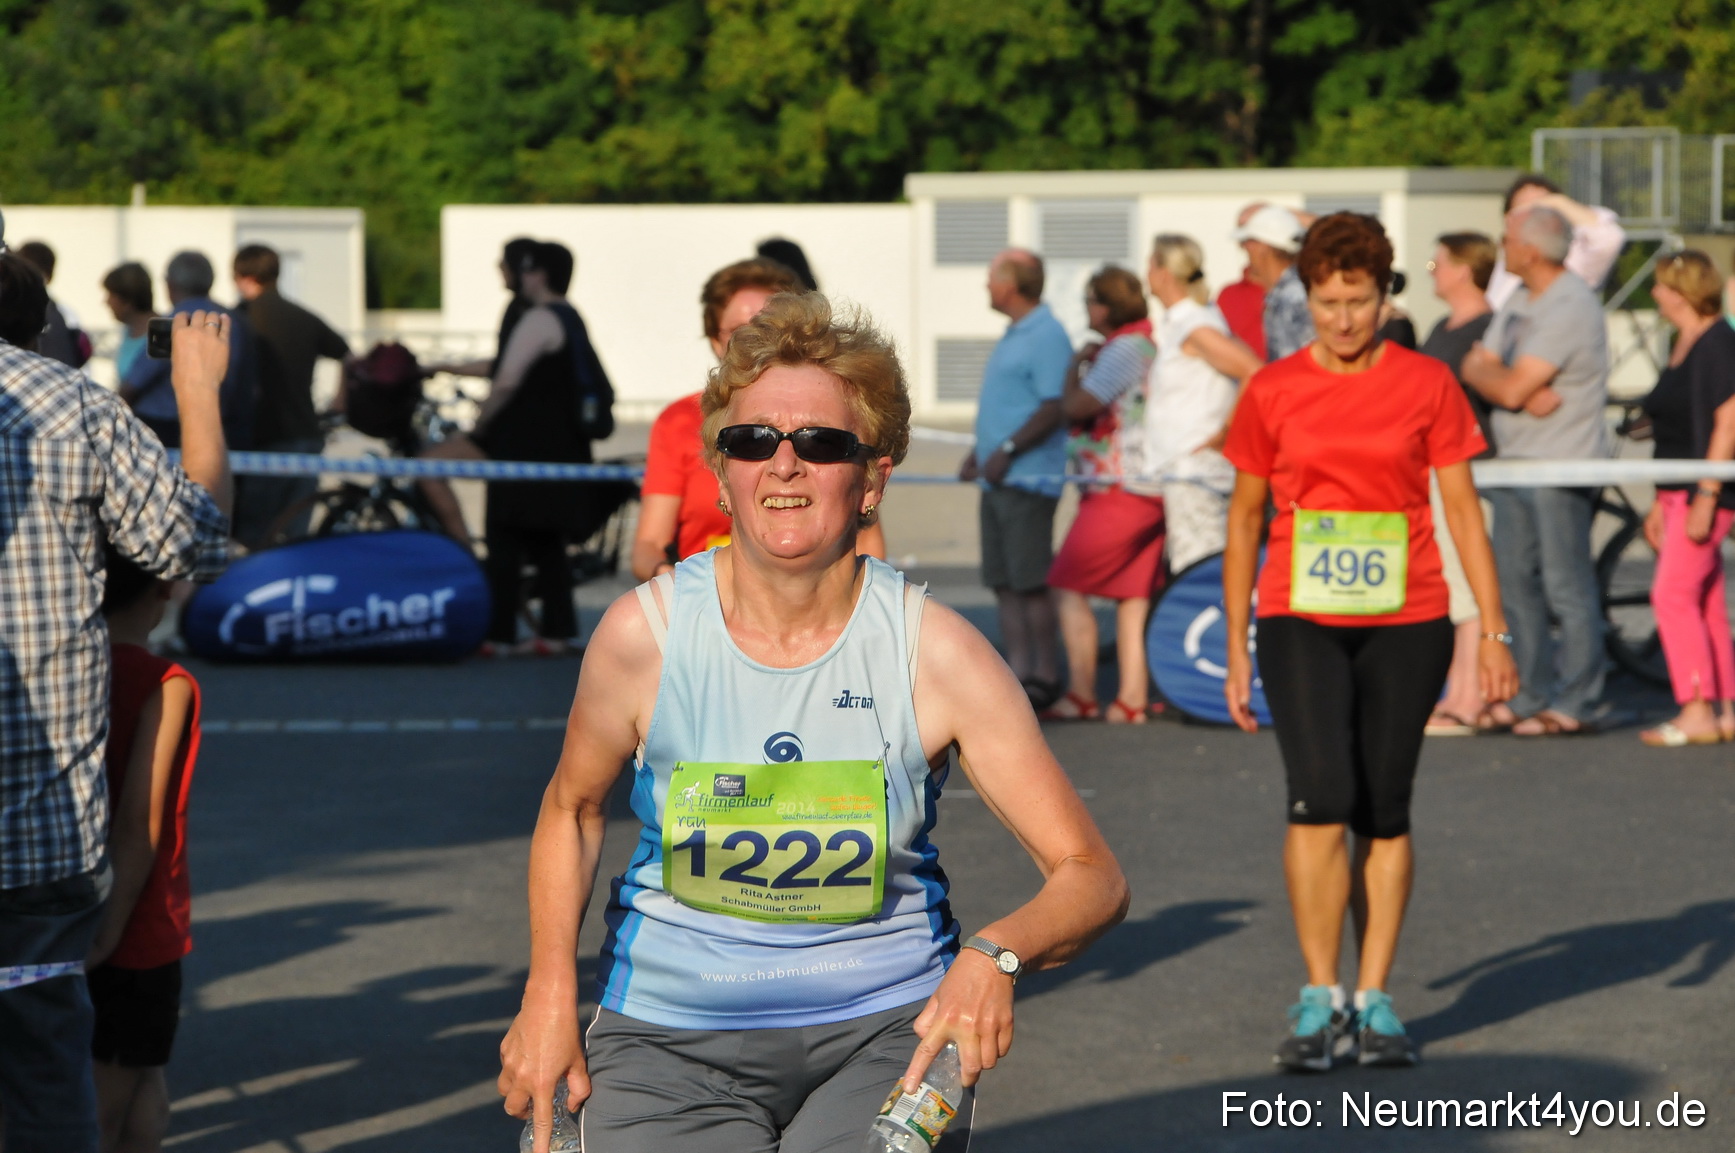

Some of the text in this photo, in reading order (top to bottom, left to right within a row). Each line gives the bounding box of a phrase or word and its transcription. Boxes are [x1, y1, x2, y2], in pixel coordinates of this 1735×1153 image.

[1308, 547, 1386, 587] 496
[263, 585, 456, 645] Fischer
[698, 793, 775, 807] firmenlauf
[776, 801, 816, 815] 2014
[672, 829, 874, 889] 1222
[721, 896, 785, 913] Schabmüller
[788, 904, 821, 912] GmbH
[740, 887, 804, 901] Rita Astner
[700, 957, 864, 983] www.schabmueller.de
